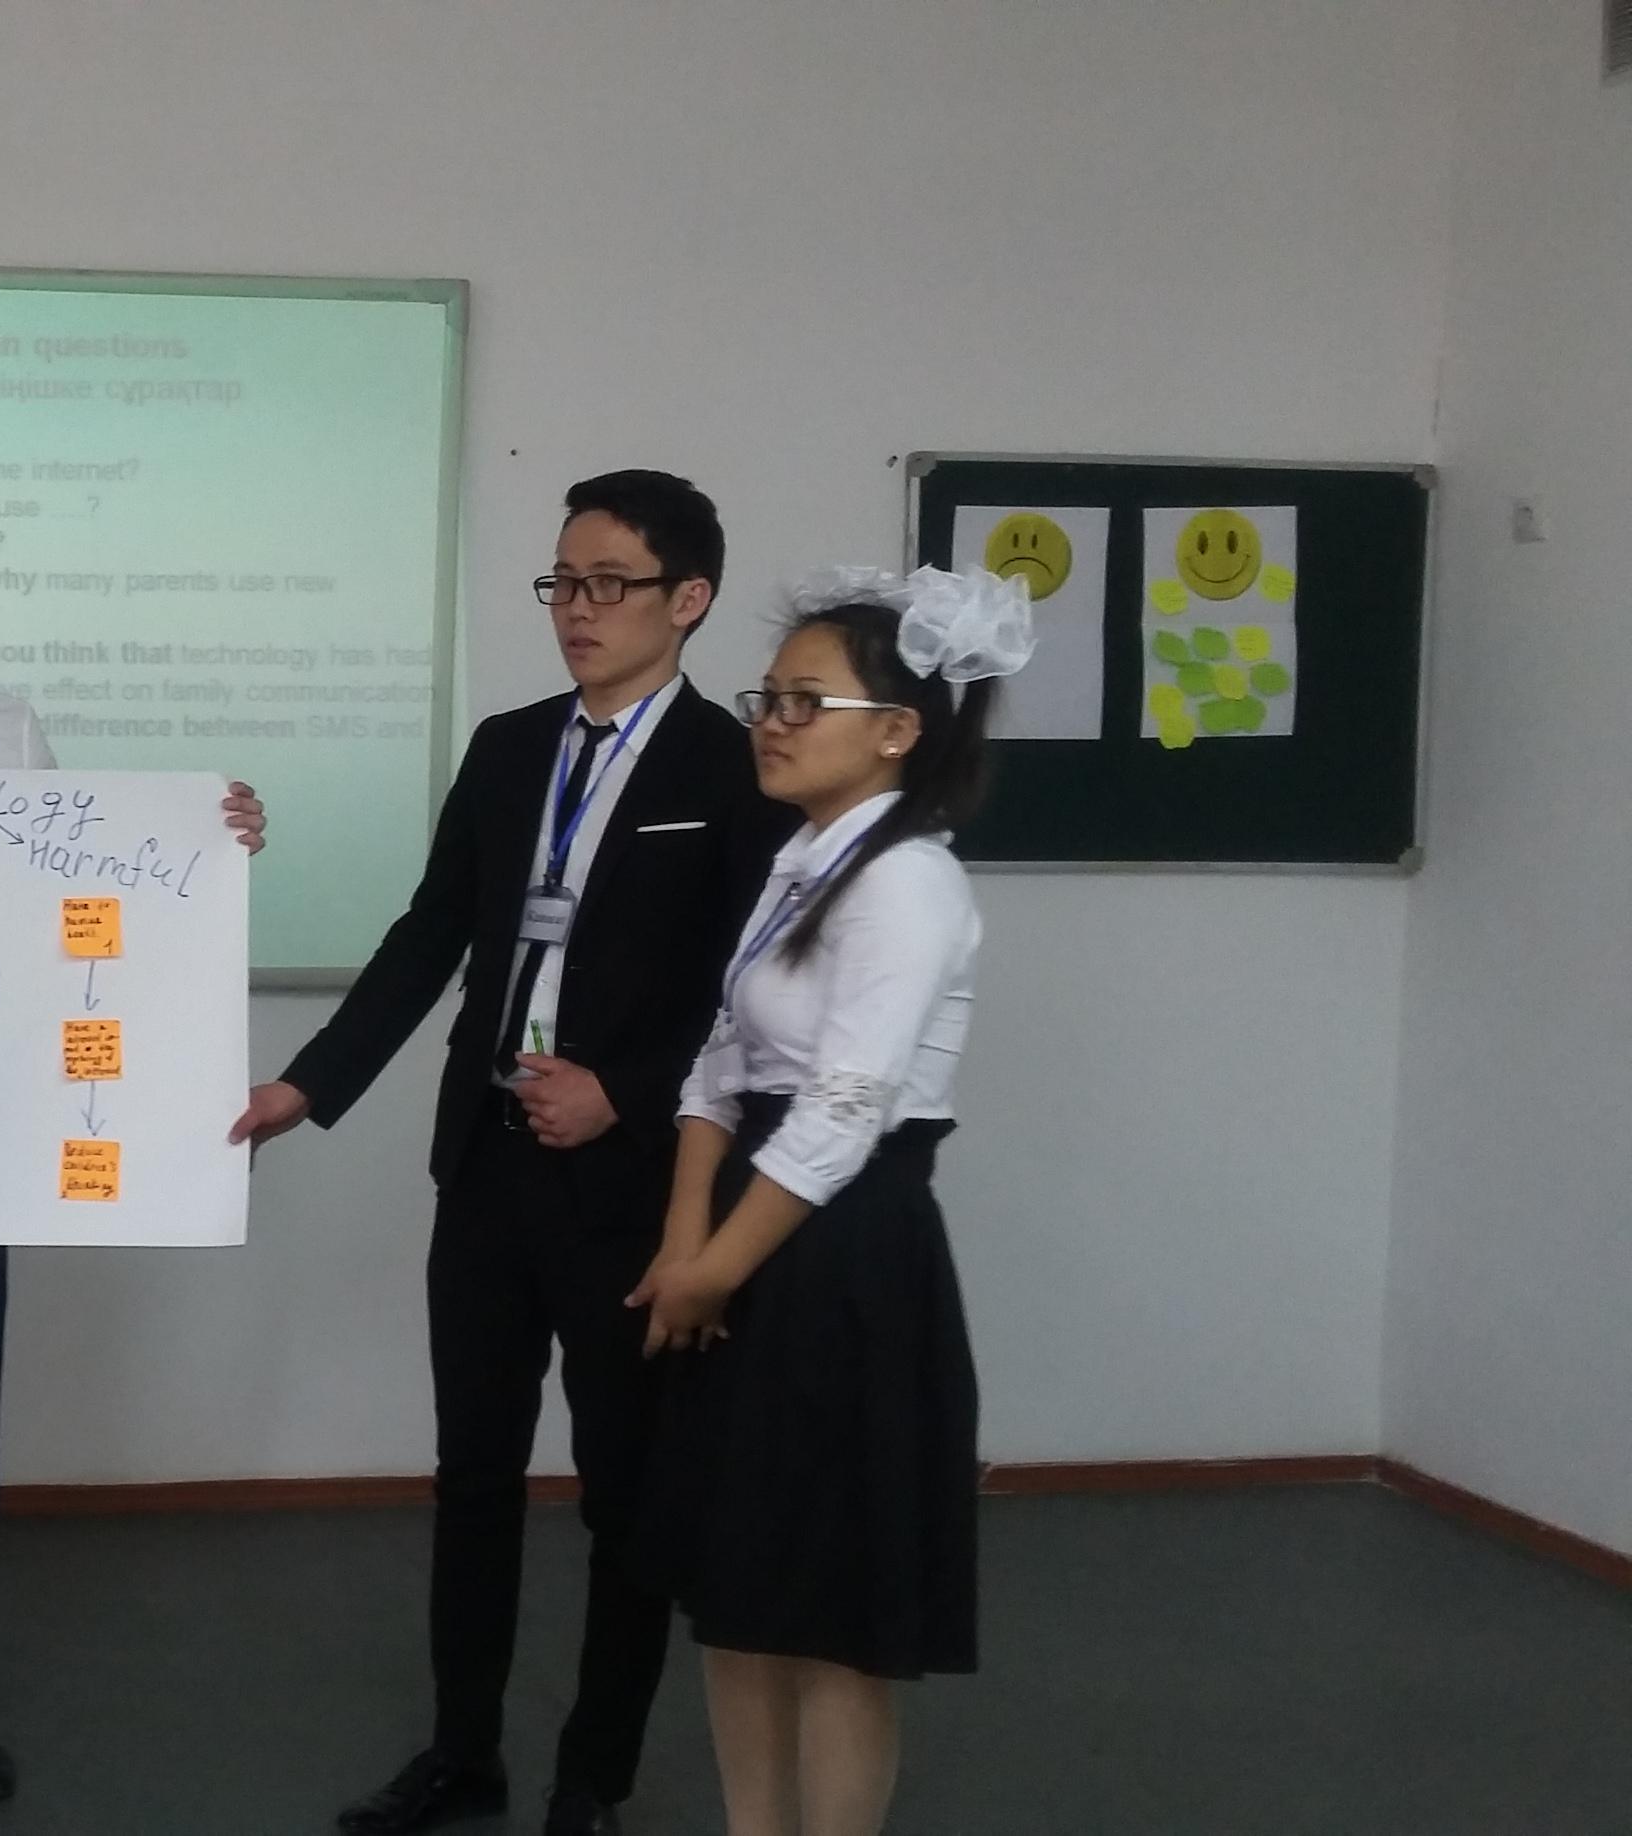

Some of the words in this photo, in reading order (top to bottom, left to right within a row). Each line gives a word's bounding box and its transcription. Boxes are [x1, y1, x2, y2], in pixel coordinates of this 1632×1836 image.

[33, 331, 190, 364] questions
[31, 458, 140, 482] internet?
[45, 570, 114, 597] many
[124, 571, 218, 597] parents
[229, 574, 276, 593] use
[284, 575, 337, 593] new
[42, 640, 110, 664] think
[120, 641, 173, 664] that
[181, 643, 317, 672] technology
[329, 643, 375, 666] has
[42, 677, 111, 701] effect
[120, 683, 153, 701] on
[162, 678, 233, 707] family
[246, 683, 435, 703] communication
[183, 714, 297, 739] between
[306, 715, 370, 739] SMS
[376, 716, 425, 739] and
[28, 837, 202, 898] Harmful
